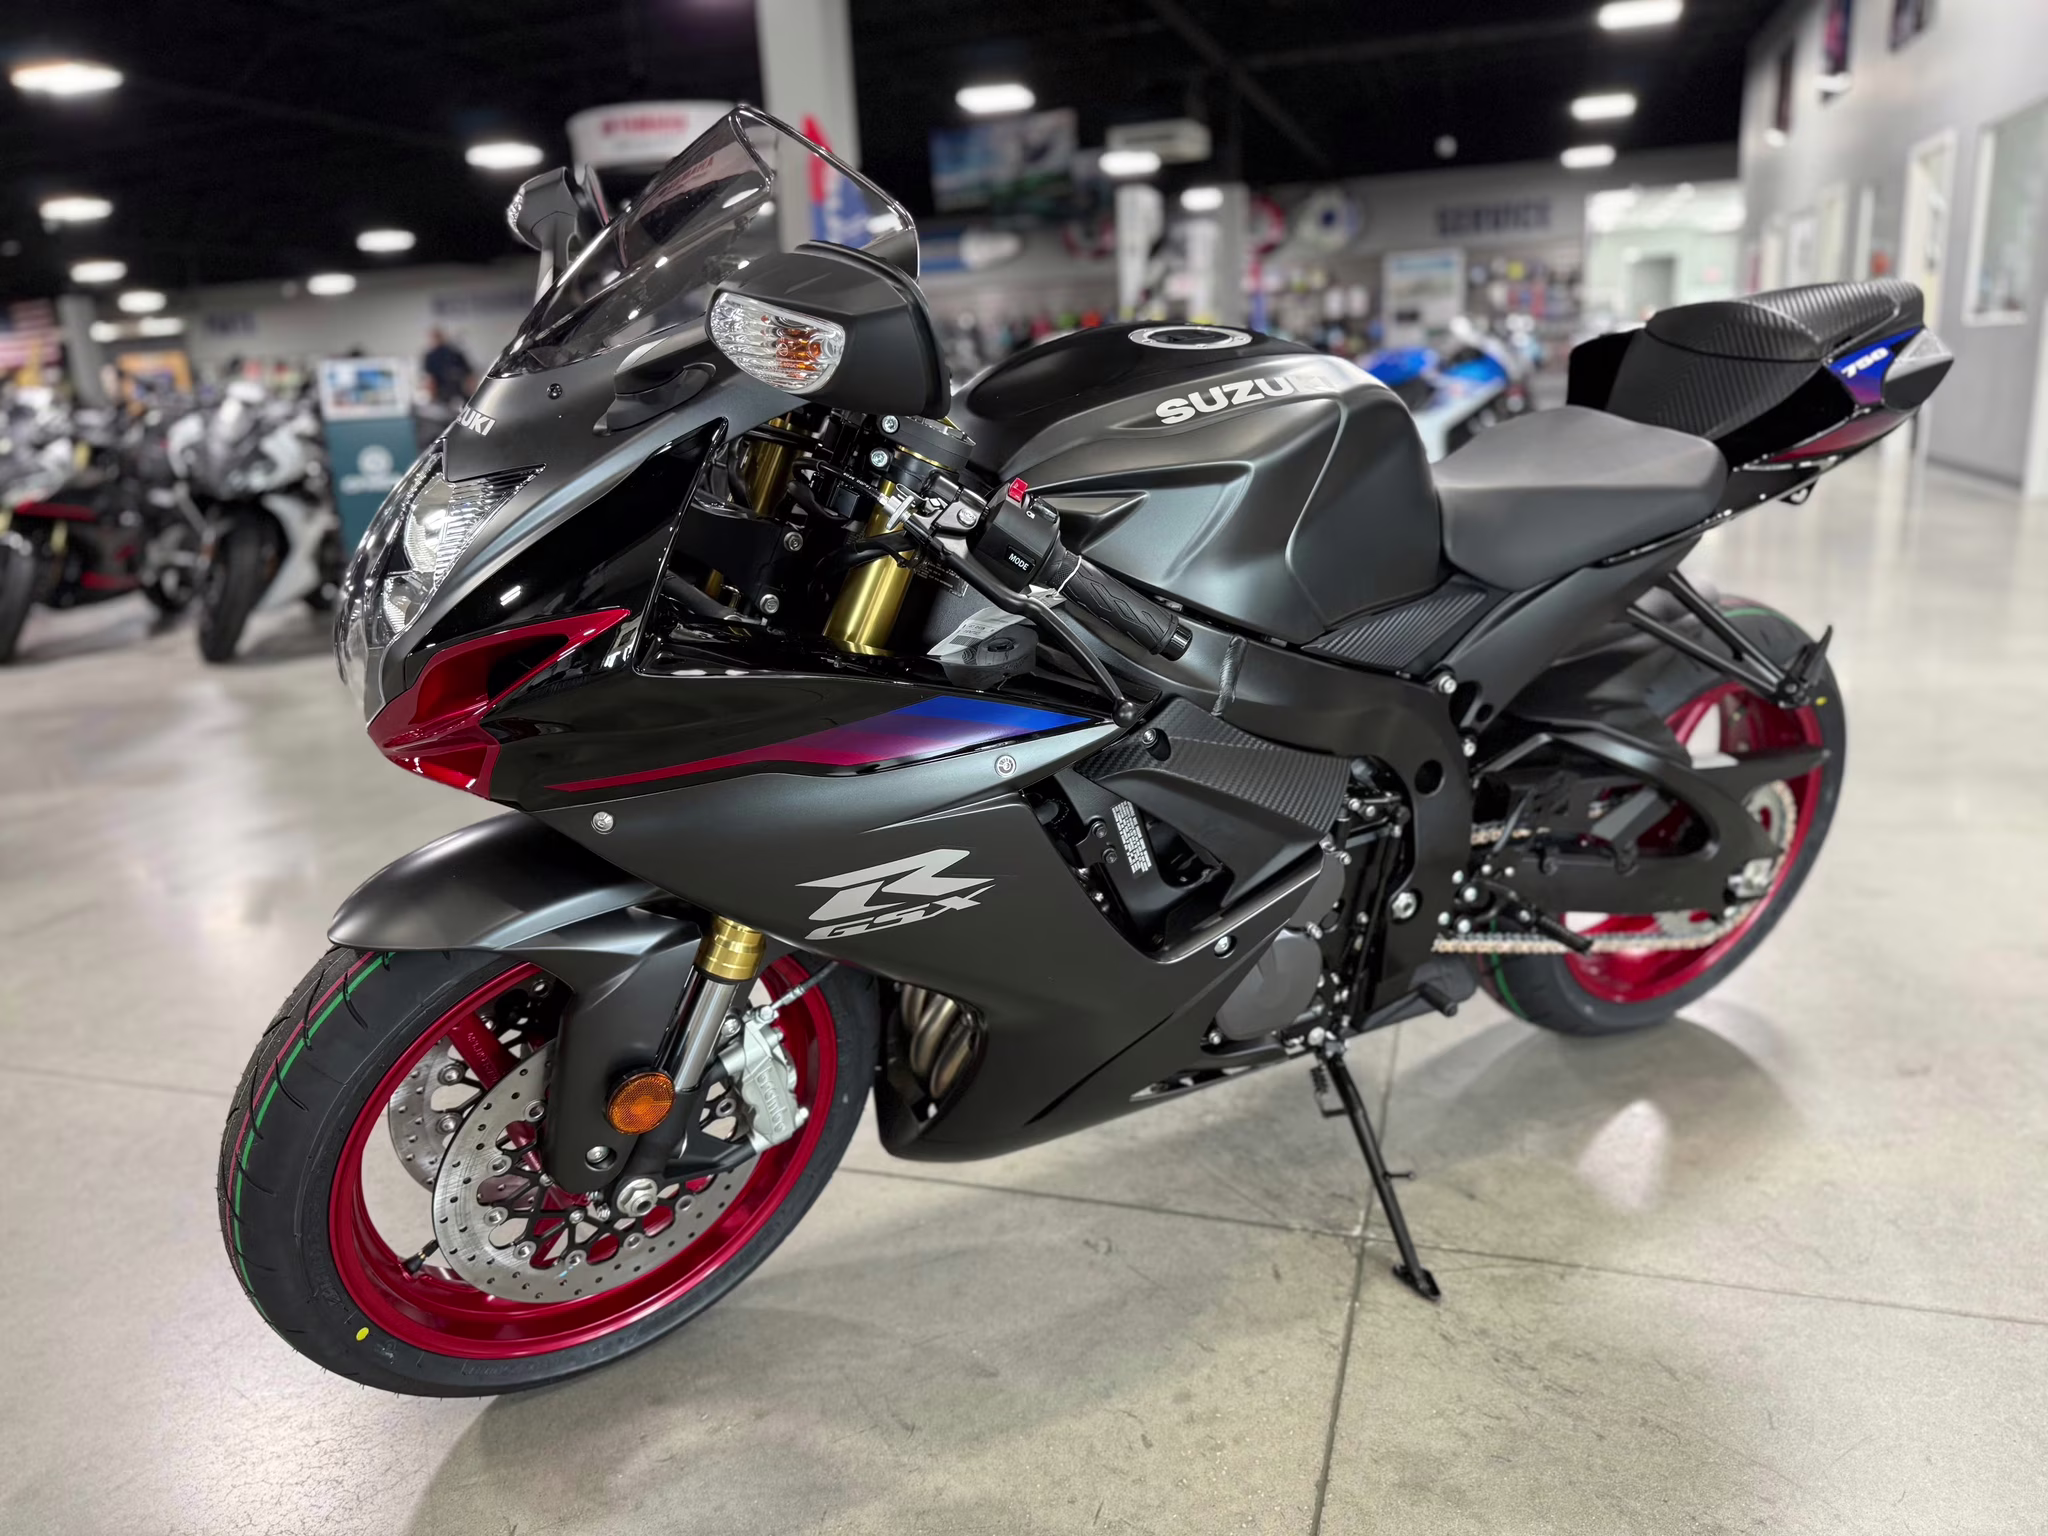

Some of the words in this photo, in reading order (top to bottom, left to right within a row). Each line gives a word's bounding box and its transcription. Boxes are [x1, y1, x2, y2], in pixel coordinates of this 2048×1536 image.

[1841, 347, 1889, 378] 750
[1008, 552, 1030, 571] MODE
[805, 884, 996, 940] GSX
[754, 1066, 788, 1133] brembo
